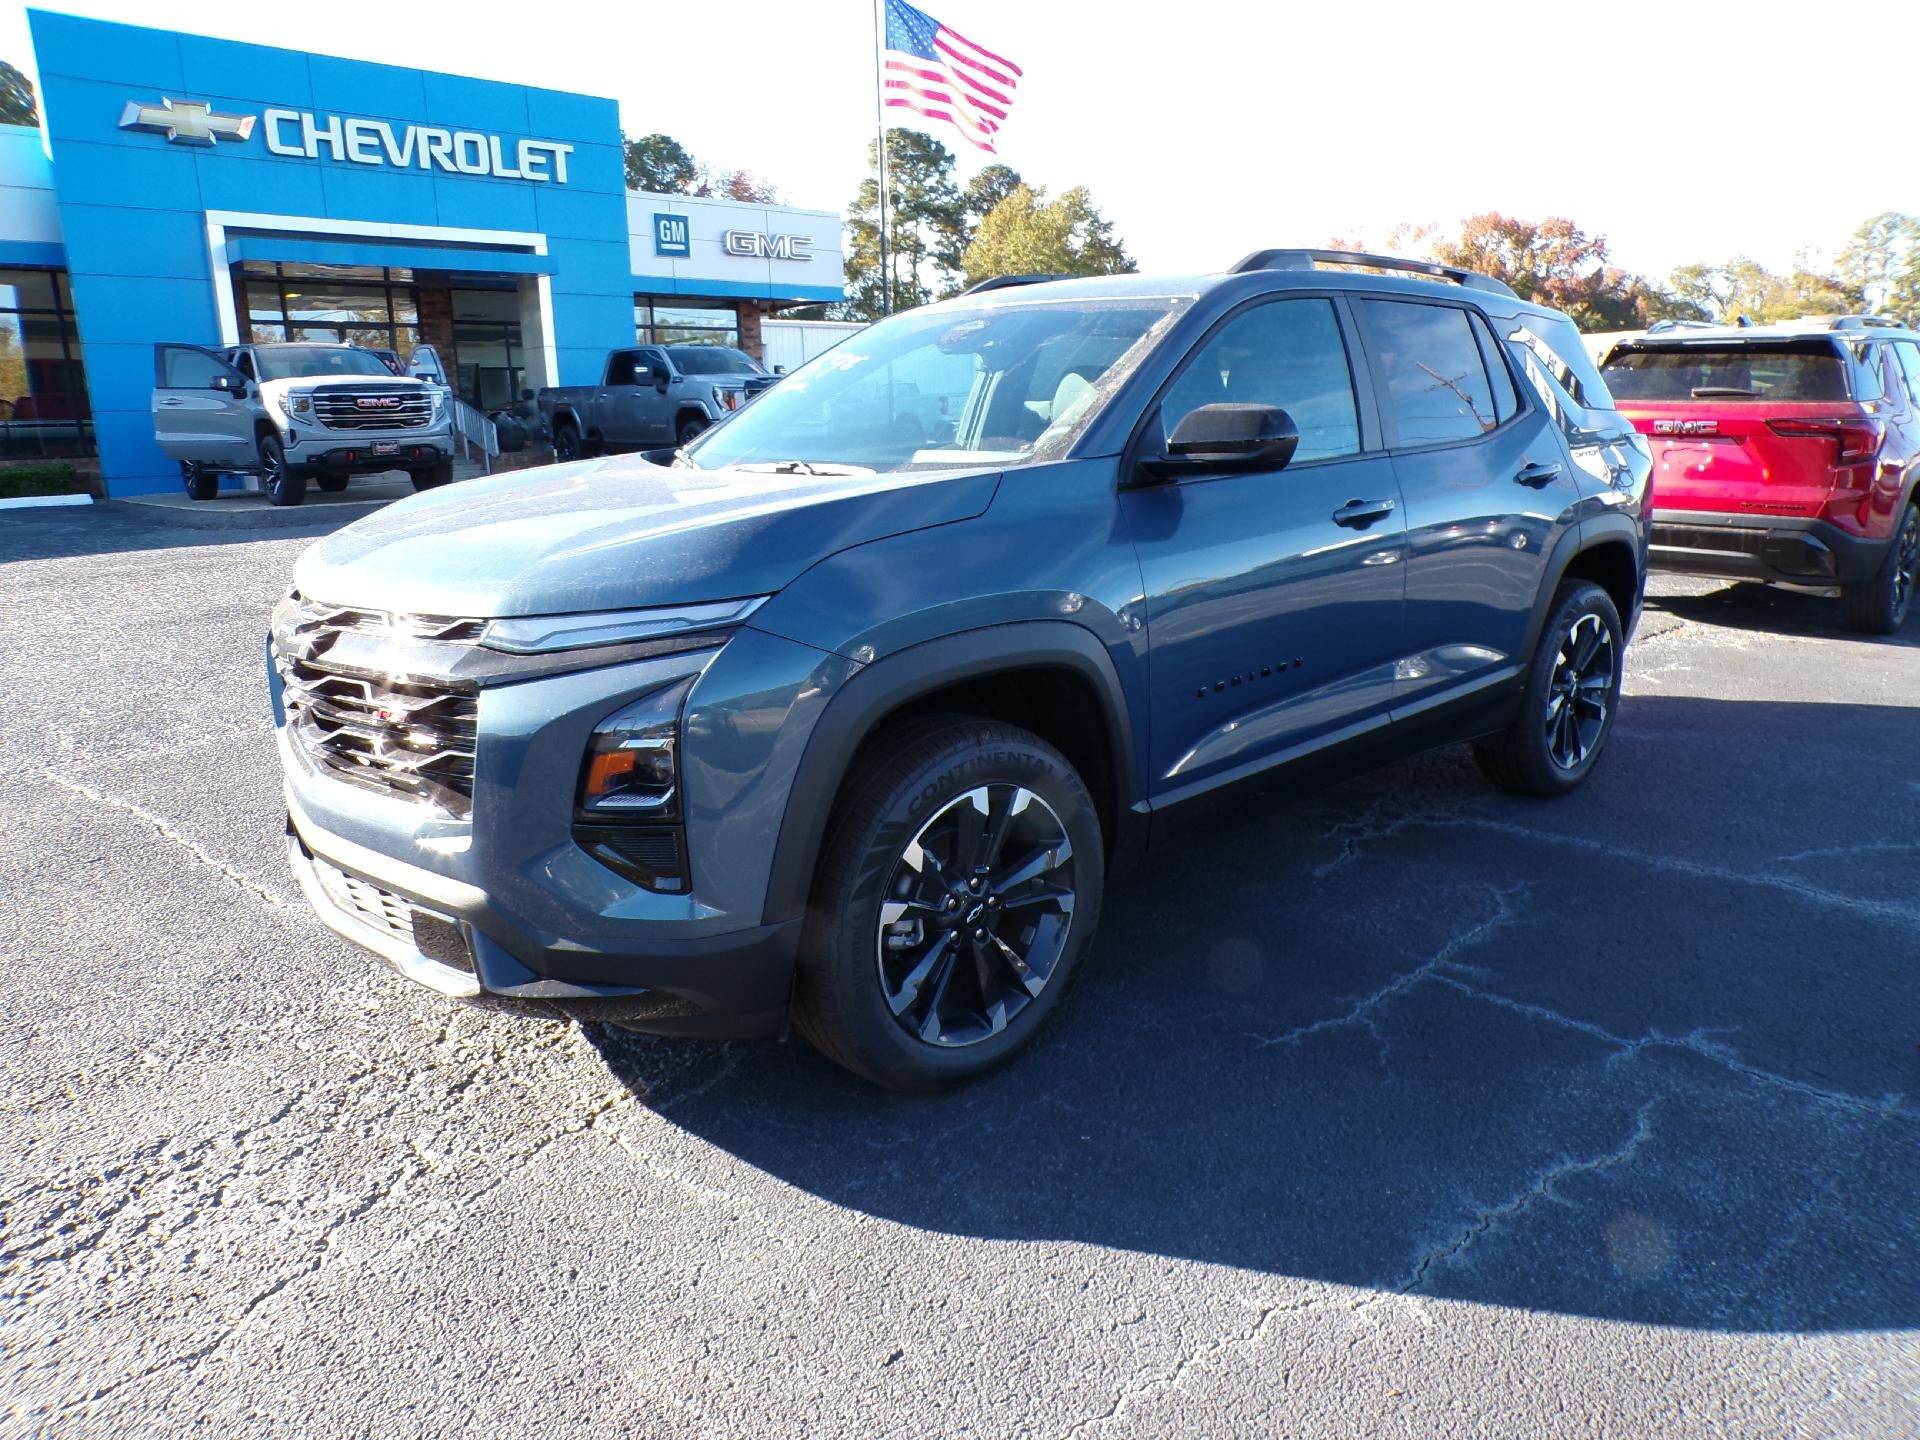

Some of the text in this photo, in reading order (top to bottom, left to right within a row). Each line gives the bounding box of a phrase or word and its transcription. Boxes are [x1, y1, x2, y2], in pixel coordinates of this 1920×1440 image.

[263, 108, 574, 183] CHEVROLET
[659, 220, 686, 243] GM
[726, 229, 815, 261] GMC
[357, 397, 400, 407] GMC
[1654, 420, 1718, 433] GMC
[908, 752, 1053, 812] CONTINENTAL
